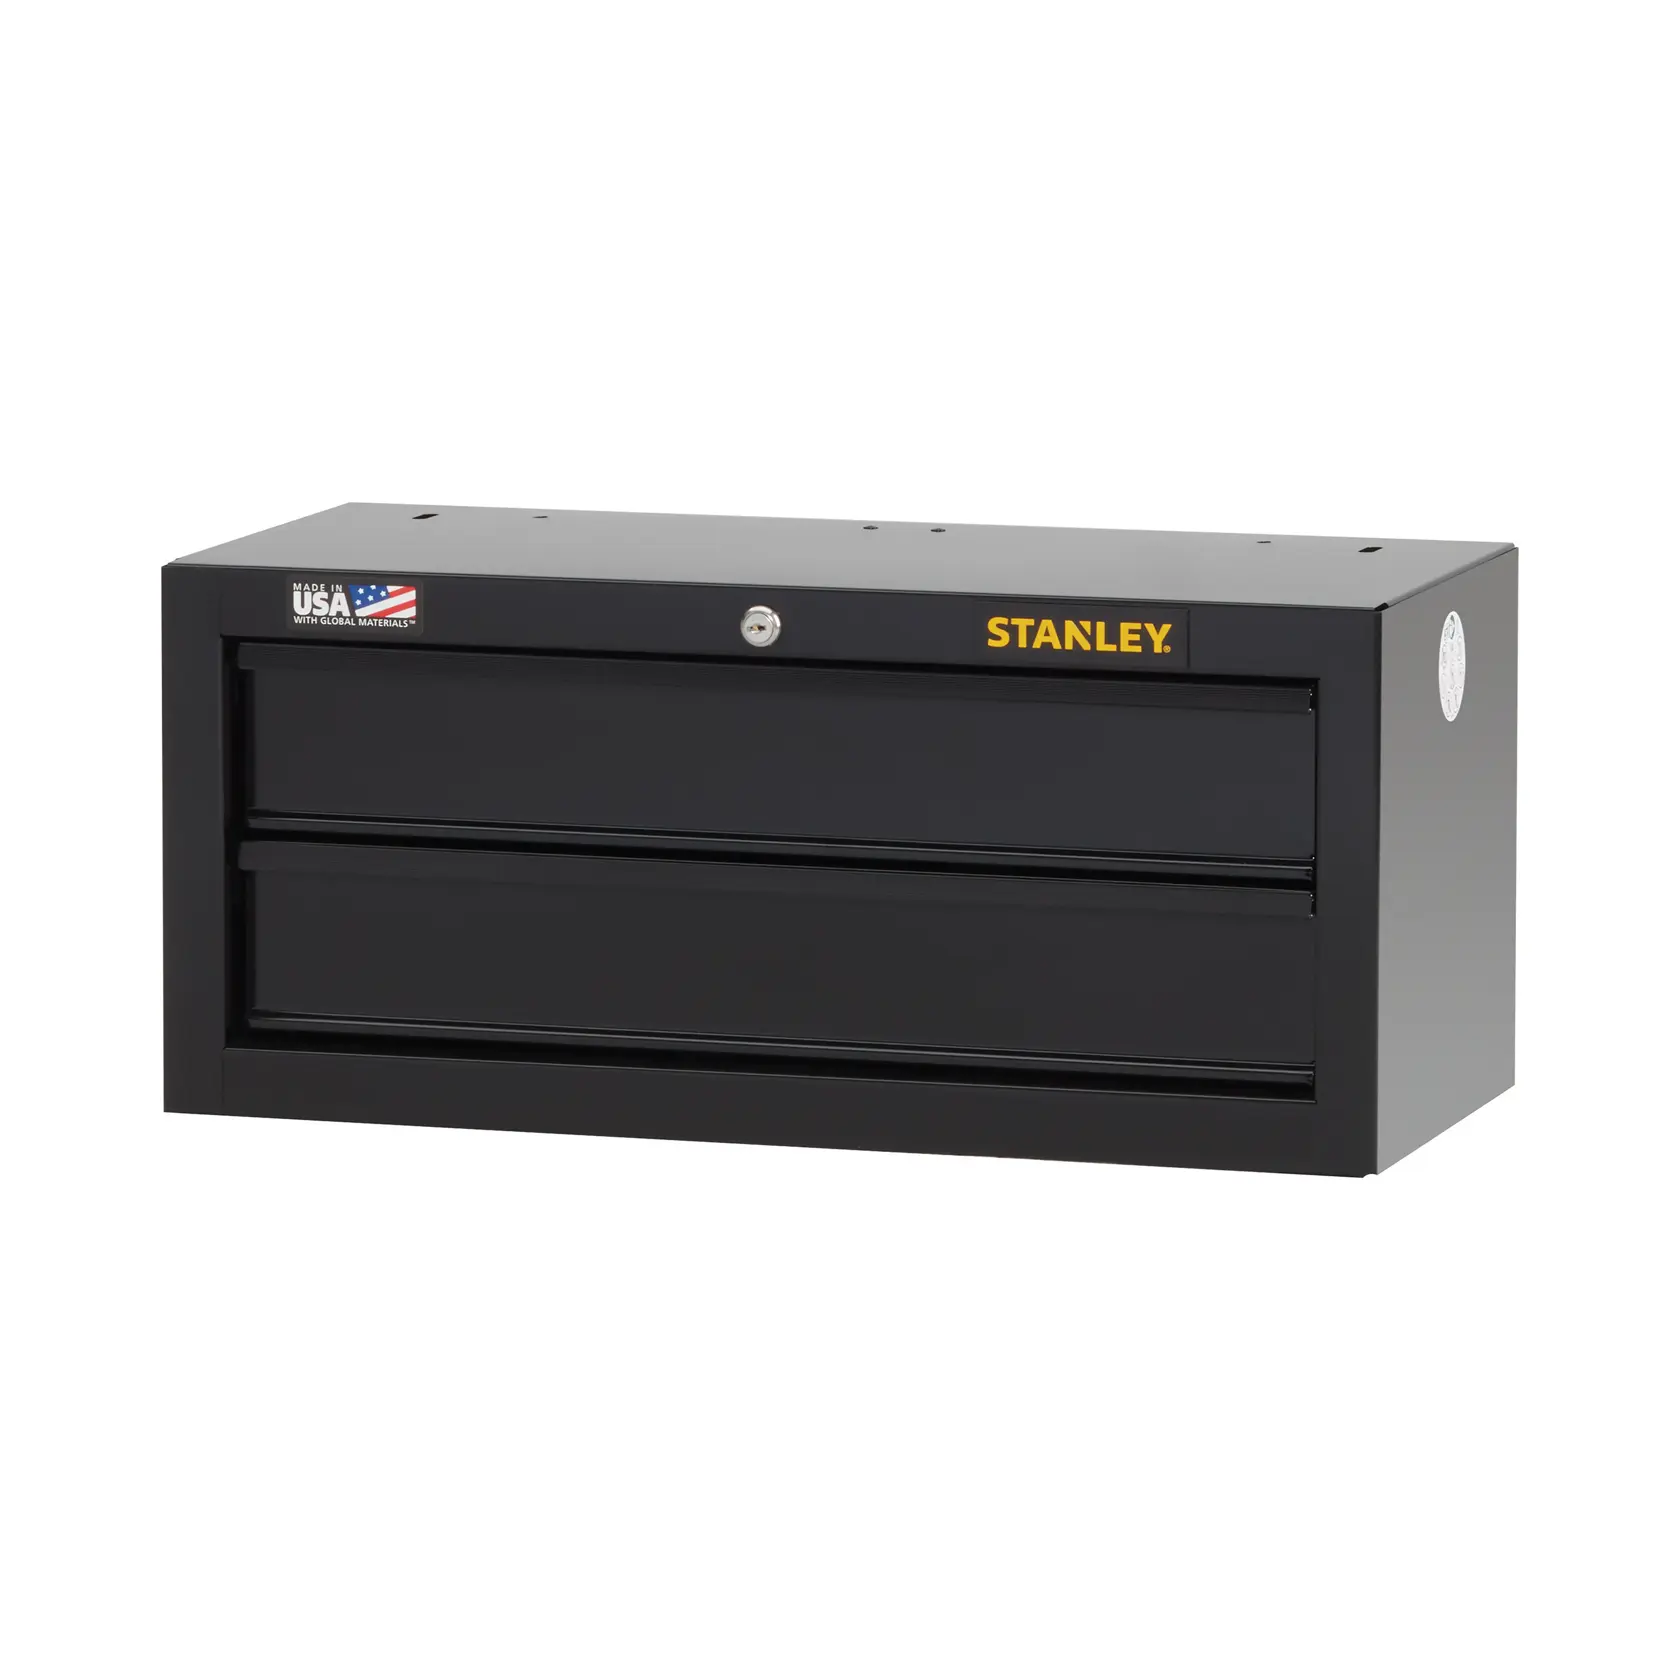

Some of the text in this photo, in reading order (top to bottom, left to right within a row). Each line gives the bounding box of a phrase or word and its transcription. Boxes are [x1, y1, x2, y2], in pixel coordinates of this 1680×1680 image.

[293, 583, 343, 593] MADE IN
[293, 591, 351, 617] USA
[293, 616, 318, 624] WITH
[320, 617, 356, 626] GLOBAL
